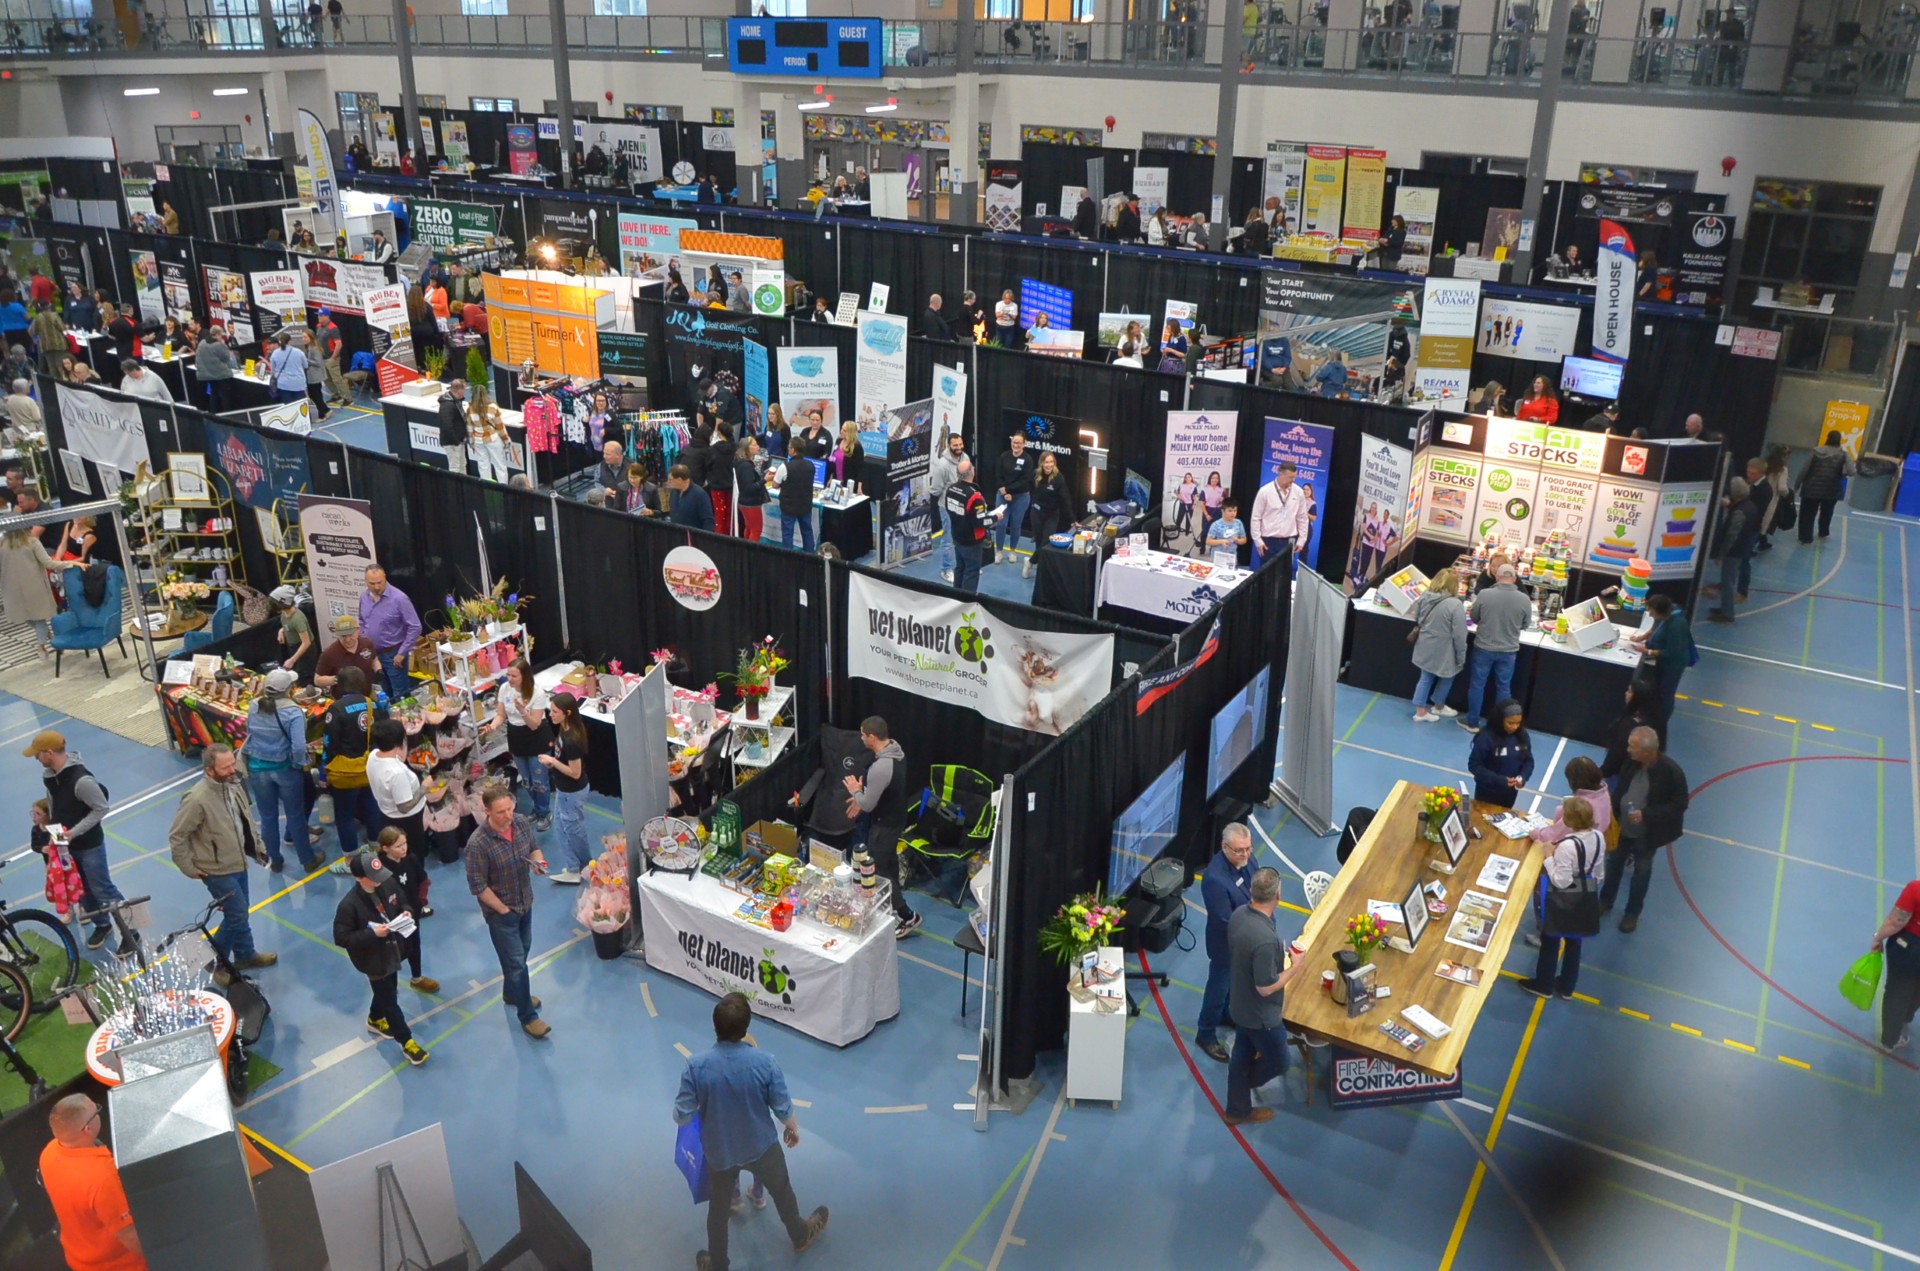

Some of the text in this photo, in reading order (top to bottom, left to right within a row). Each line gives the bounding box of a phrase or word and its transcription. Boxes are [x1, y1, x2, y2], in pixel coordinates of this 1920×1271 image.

[740, 26, 760, 36] HOME
[839, 26, 867, 38] GUEST
[784, 57, 806, 66] PERIOD
[307, 124, 328, 179] BLINDS
[618, 140, 647, 155] MEN IN
[414, 206, 452, 224] ZERO
[544, 214, 588, 224] pampered chef
[417, 224, 454, 236] CLOGGED
[620, 221, 671, 236] LOVE IT HERE.
[418, 234, 455, 246] GUTTERS
[621, 235, 647, 247] WE DO!
[258, 275, 295, 286] BIG BEN
[1281, 278, 1304, 287] START
[369, 290, 400, 304] BIG BEN
[1280, 289, 1334, 301] OPPORTUNITY
[1435, 289, 1475, 300] CRYSTAL
[1265, 297, 1293, 307] Your APL
[1435, 297, 1475, 306] ADAMO
[1606, 261, 1622, 348] OPEN HOUSE
[666, 309, 692, 332] JQ
[706, 320, 719, 330] Golf
[720, 323, 746, 334] Clothing
[534, 322, 586, 347] TurmeriX
[859, 356, 904, 369] Bowen Technique
[1424, 378, 1460, 387] RE/MAX
[1829, 410, 1860, 421] Drop-in
[411, 427, 440, 447] Turm
[1174, 434, 1228, 443] Make your home
[1279, 433, 1316, 444] MOLLY MAID
[1514, 426, 1581, 449] FLAT
[1035, 441, 1071, 455] & Morton
[1171, 443, 1230, 452] MOLLY MAID Clean!
[1271, 440, 1323, 457] Relax, leave the
[911, 454, 929, 463] Morton
[1177, 457, 1221, 466] 403.470.6482
[1272, 451, 1319, 467] cleaning to us!
[1366, 460, 1400, 480] You'll Just Love
[1431, 458, 1477, 477] FLAT
[1365, 470, 1398, 491] Coming Home!
[1490, 473, 1510, 483] BPA
[1490, 480, 1508, 488] FREE
[1544, 476, 1593, 490] FOOD GRADE
[1364, 484, 1395, 505] 403.470.6482
[1549, 485, 1585, 496] SILICONE
[1613, 488, 1643, 500] WOW!
[1545, 492, 1587, 504] 100% SAFE
[1556, 501, 1572, 510] USE
[1607, 507, 1625, 516] 60%
[1613, 501, 1637, 511] SAVE
[328, 519, 351, 527] works
[1607, 515, 1638, 526] SPACE
[1165, 600, 1205, 616] MOLLY
[868, 608, 951, 654] pet planet
[870, 645, 988, 688] YOUR PET'S Natural GROCER
[885, 666, 979, 699] www.shoppetplanet.ca
[706, 940, 754, 983] planet
[757, 998, 796, 1013] GROCER
[1338, 1060, 1366, 1076] FIRE
